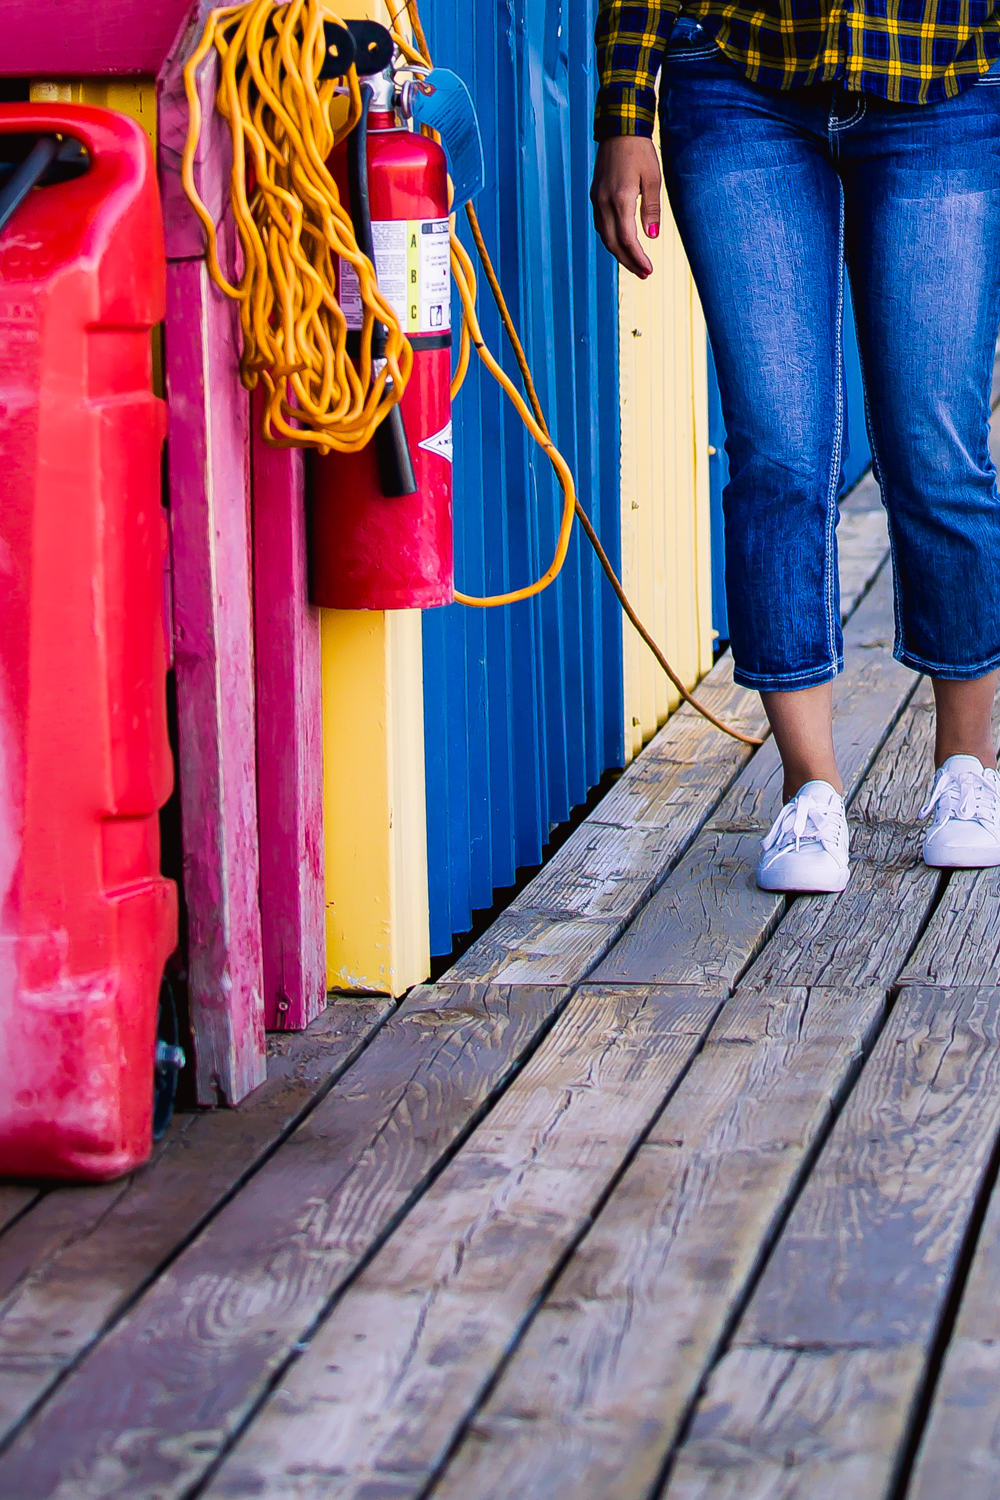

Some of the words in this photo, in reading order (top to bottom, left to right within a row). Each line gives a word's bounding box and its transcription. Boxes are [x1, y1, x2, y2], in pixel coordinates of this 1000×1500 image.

[410, 233, 417, 248] A
[410, 269, 417, 283] B
[410, 305, 417, 319] C
